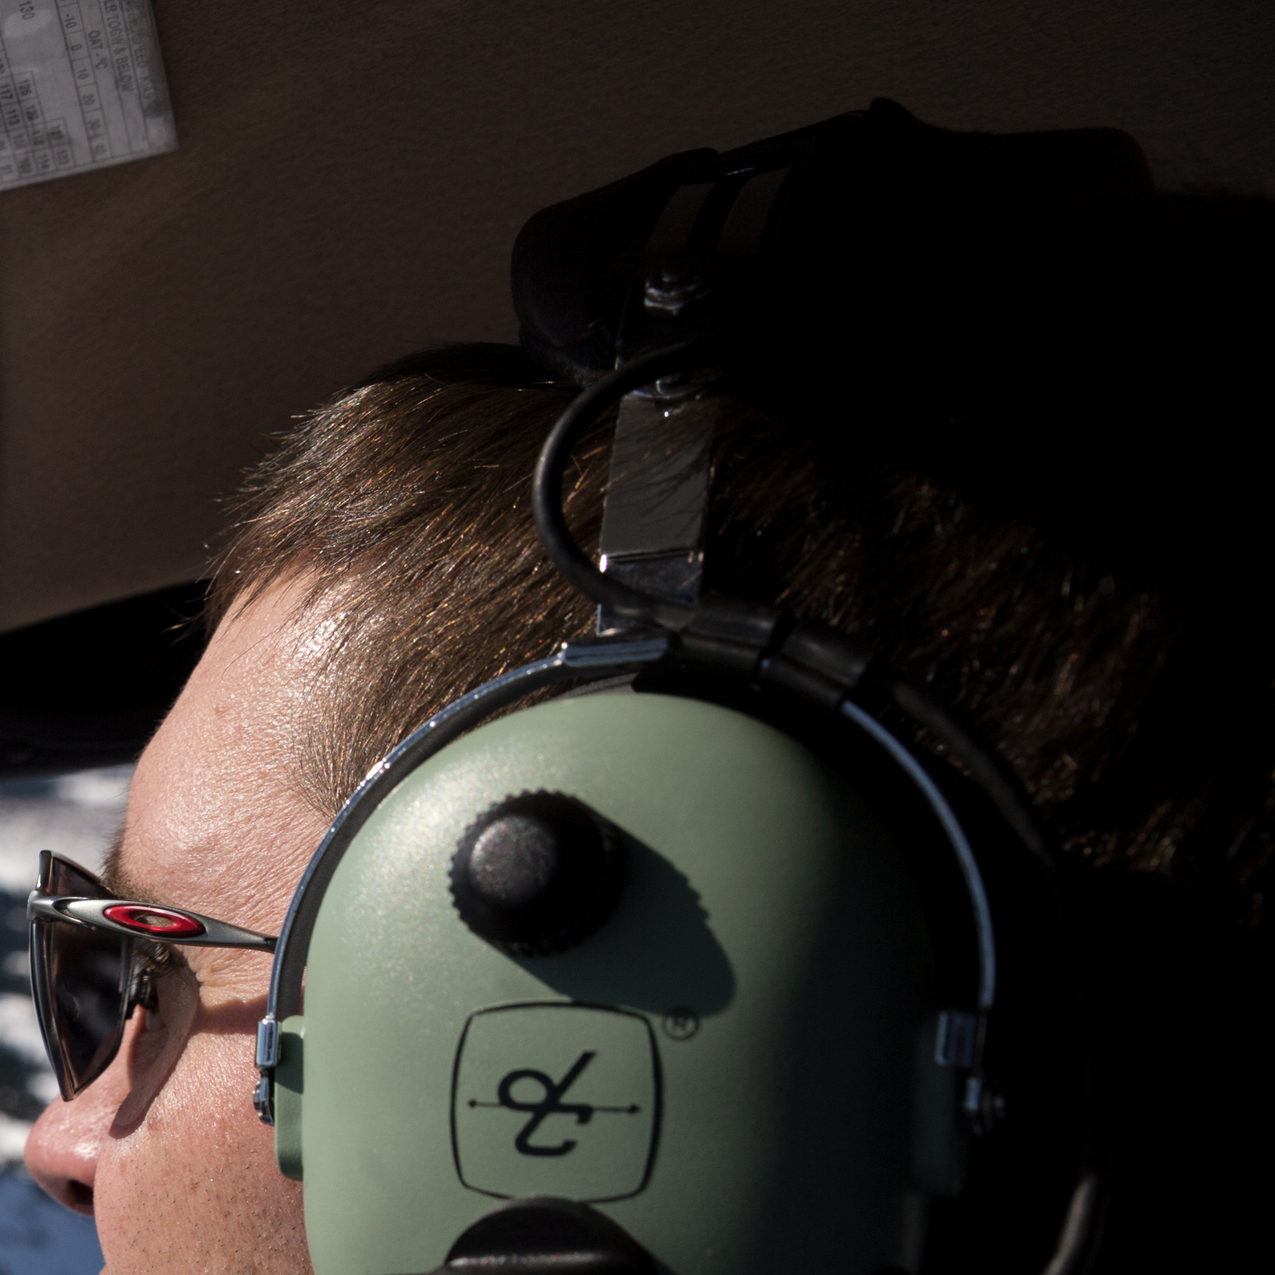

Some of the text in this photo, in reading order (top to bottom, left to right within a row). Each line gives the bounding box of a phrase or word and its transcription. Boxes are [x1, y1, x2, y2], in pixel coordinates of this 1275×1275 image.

[17, 0, 36, 20] 130
[62, 12, 77, 29] -10
[70, 43, 82, 51] 0
[87, 29, 103, 51] OAT
[107, 14, 123, 45] TOGW
[115, 55, 134, 93] BELOW
[75, 68, 89, 80] 10
[16, 78, 33, 96] 126
[81, 92, 95, 106] 20
[5, 109, 20, 126] 113
